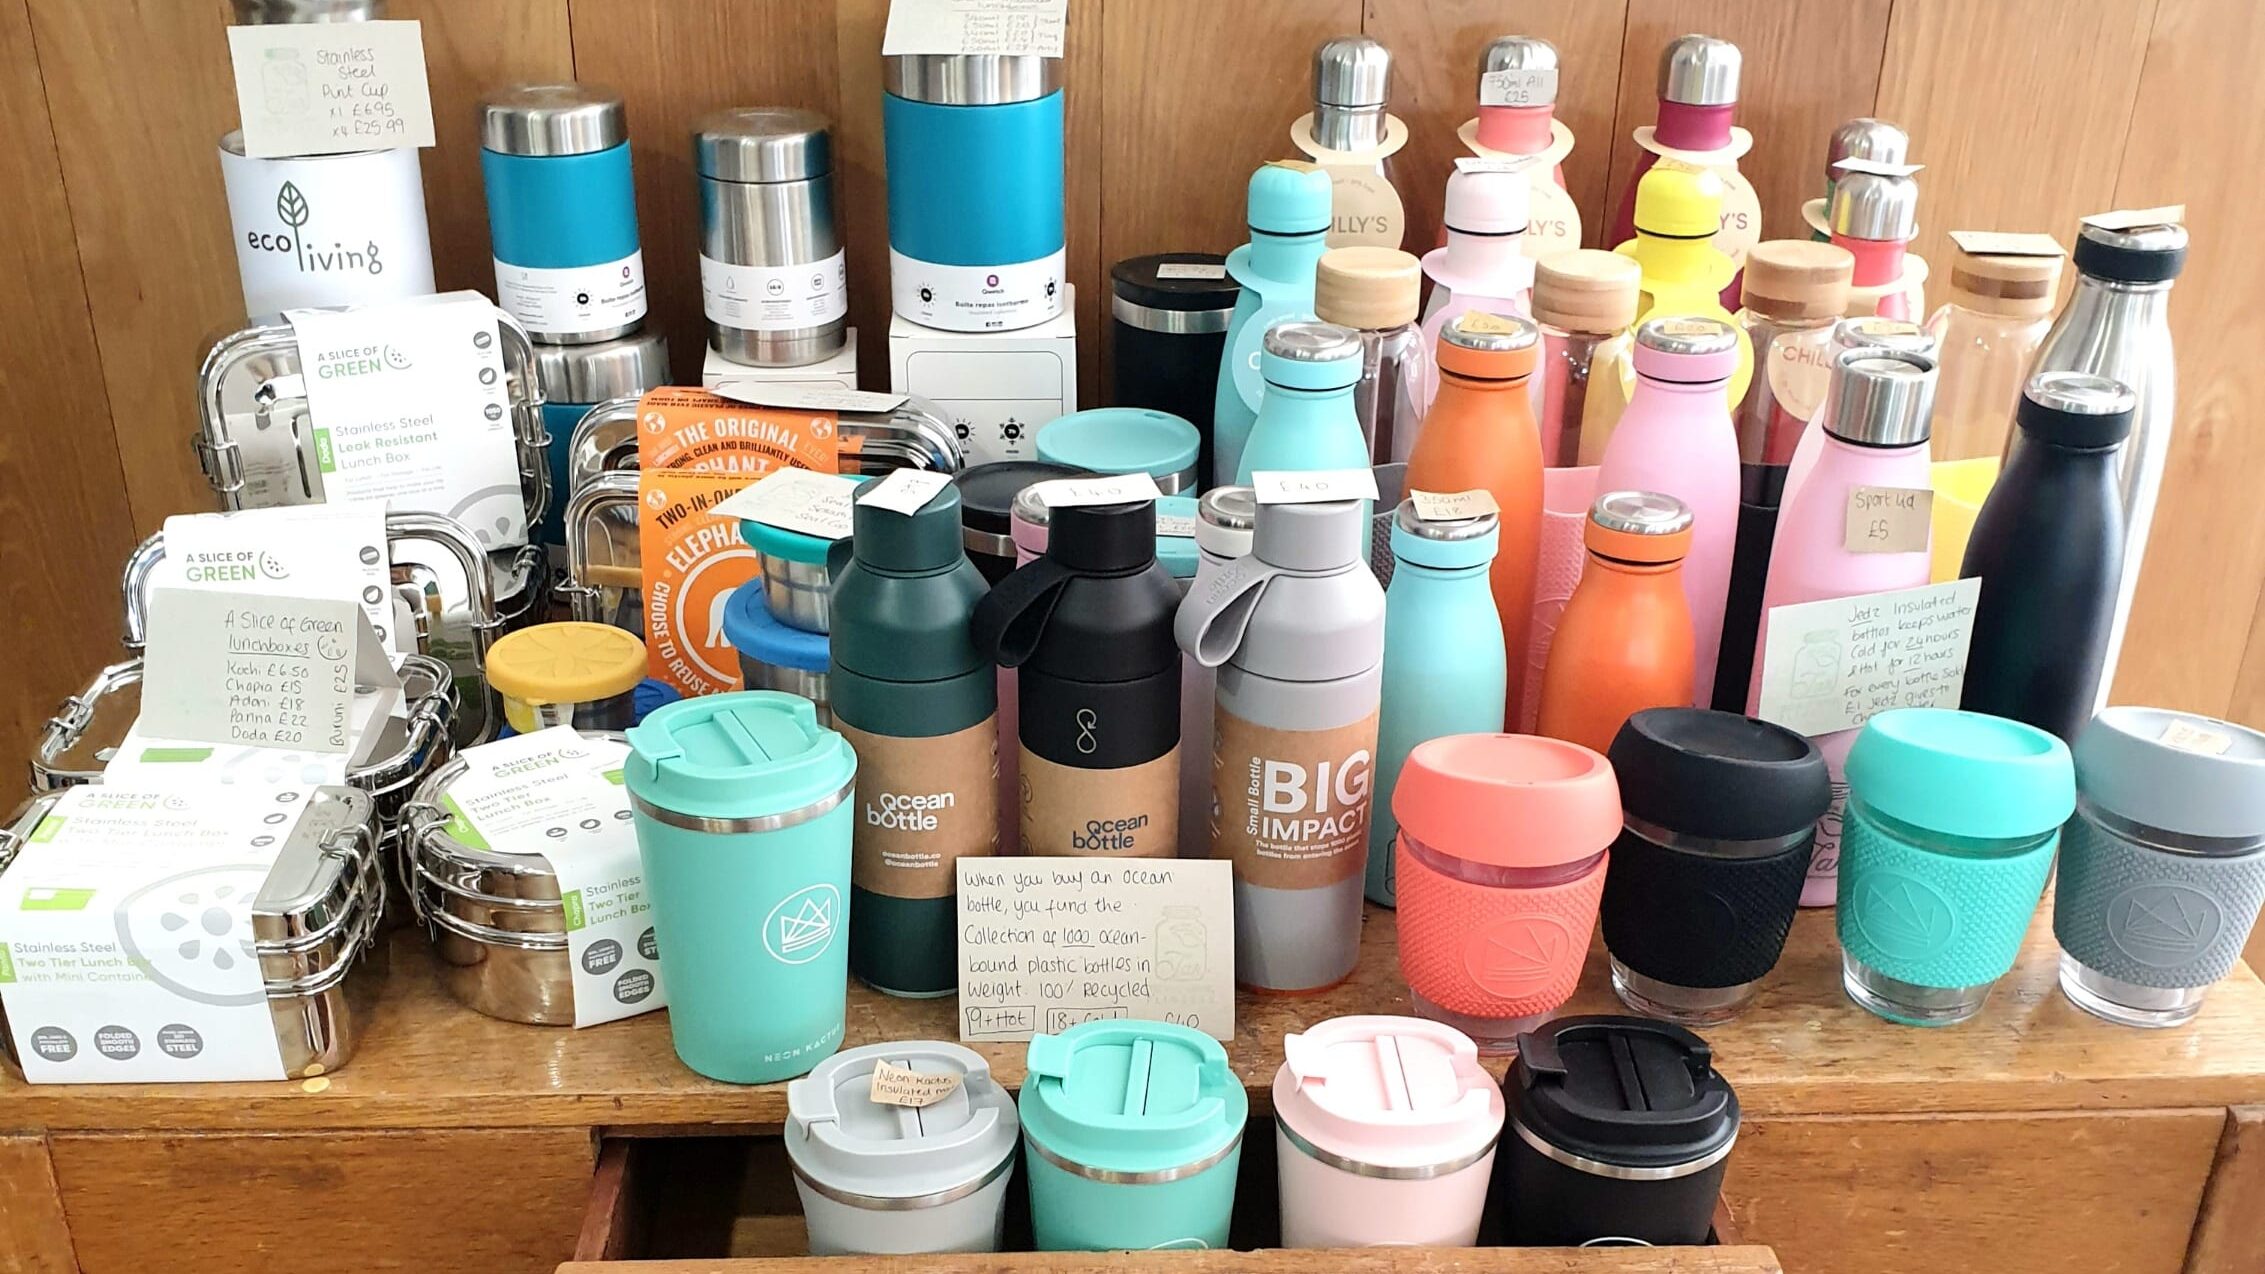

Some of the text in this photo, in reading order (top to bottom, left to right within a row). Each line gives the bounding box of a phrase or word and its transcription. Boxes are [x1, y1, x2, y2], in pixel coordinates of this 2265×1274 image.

[316, 48, 374, 65] Stainless
[338, 65, 377, 79] Steel
[361, 82, 389, 99] Cup
[1331, 216, 1388, 233] ILLY'S
[318, 346, 379, 362] A SLICE OF
[318, 358, 382, 379] GREEN
[335, 414, 434, 437] Stainless Steel
[674, 417, 799, 452] THE ORIGINAL
[338, 431, 438, 453] Leak Resistant
[693, 443, 719, 458] CLEAN
[721, 440, 738, 451] AND
[739, 440, 789, 462] BRILLIANTLY
[341, 451, 411, 470] Lunch Box
[656, 487, 742, 529] TWO-IN-ON
[1855, 493, 1891, 512] Sport
[1868, 519, 1889, 540] £5
[665, 521, 748, 573] ELEPHA
[186, 552, 254, 563] A SLICE OF
[186, 565, 256, 582] GREEN
[1893, 591, 1956, 616] Insulated
[224, 609, 344, 637] A Slice of Green
[228, 634, 309, 655] lunchboxes
[651, 581, 710, 695] CHOOSE TO REUSE
[1924, 628, 1960, 644] hours
[280, 697, 305, 711] £18
[279, 712, 309, 727] £22
[275, 728, 303, 743] £20
[494, 757, 561, 778] GREEN
[502, 757, 534, 768] SLICE
[537, 751, 553, 761] OF
[465, 773, 570, 807] Stainless Steel
[1263, 749, 1371, 814] BIG
[77, 799, 157, 810] GREEN
[470, 791, 532, 813] Two Tier
[1246, 756, 1262, 836] Small Bottle
[477, 797, 551, 821] Lunch Box
[866, 803, 938, 831] bottle
[1262, 801, 1368, 842] IMPACT
[1072, 830, 1135, 850] bottle
[586, 875, 641, 897] Stainless
[1013, 872, 1043, 893] you
[1052, 870, 1084, 892] buy
[1090, 871, 1113, 884] an
[589, 897, 613, 911] Two
[617, 891, 641, 904] Tier
[1013, 901, 1040, 921] you
[1045, 900, 1088, 919] fund
[1095, 897, 1123, 913] the
[590, 908, 627, 925] Lunch
[1042, 929, 1057, 946] of
[1062, 927, 1090, 944] 1000
[14, 941, 117, 954] Stainless Steel
[17, 956, 123, 968] Two Tier Lunch
[588, 953, 617, 969] FREE
[968, 955, 1151, 975] bound plastic bottles in
[22, 971, 51, 982] with
[617, 974, 649, 986] FOLDED
[618, 985, 650, 999] EDGES
[98, 1032, 133, 1040] FOLDED
[40, 1044, 71, 1053] FREE
[102, 1044, 137, 1053] EDGES
[166, 1044, 199, 1052] STEEL
[764, 1048, 801, 1063] NEON
[879, 1068, 911, 1083] Neon
[876, 1082, 932, 1097] Insulated
